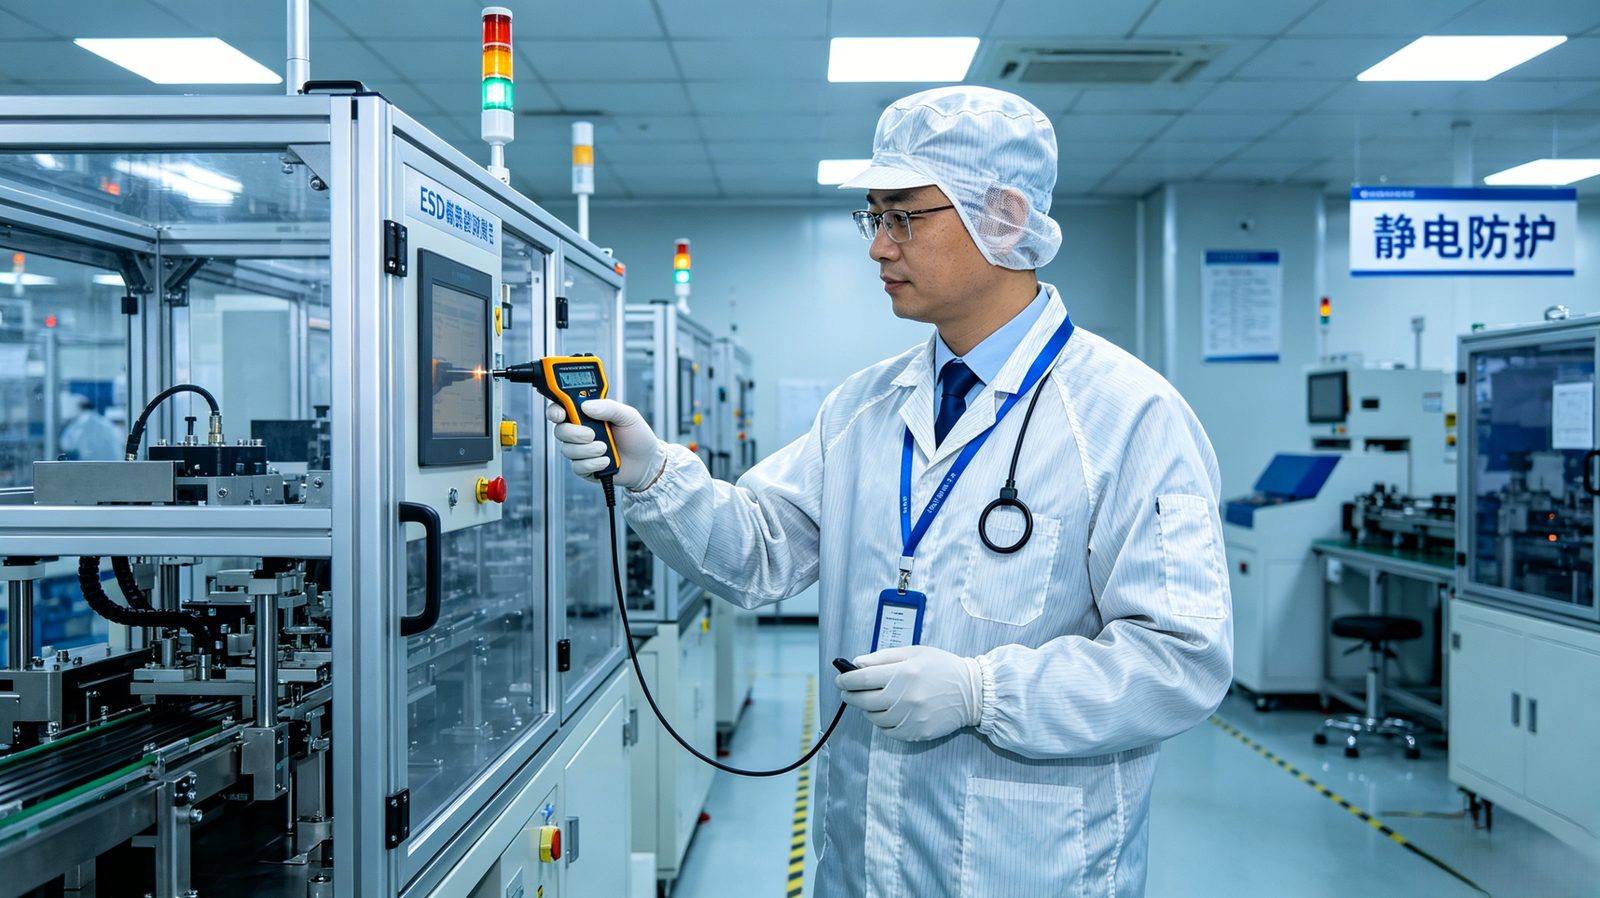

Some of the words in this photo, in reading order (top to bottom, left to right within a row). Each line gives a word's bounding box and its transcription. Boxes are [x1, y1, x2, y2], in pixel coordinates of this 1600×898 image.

[420, 185, 445, 220] ESD
[1373, 213, 1556, 260] 静电防护
